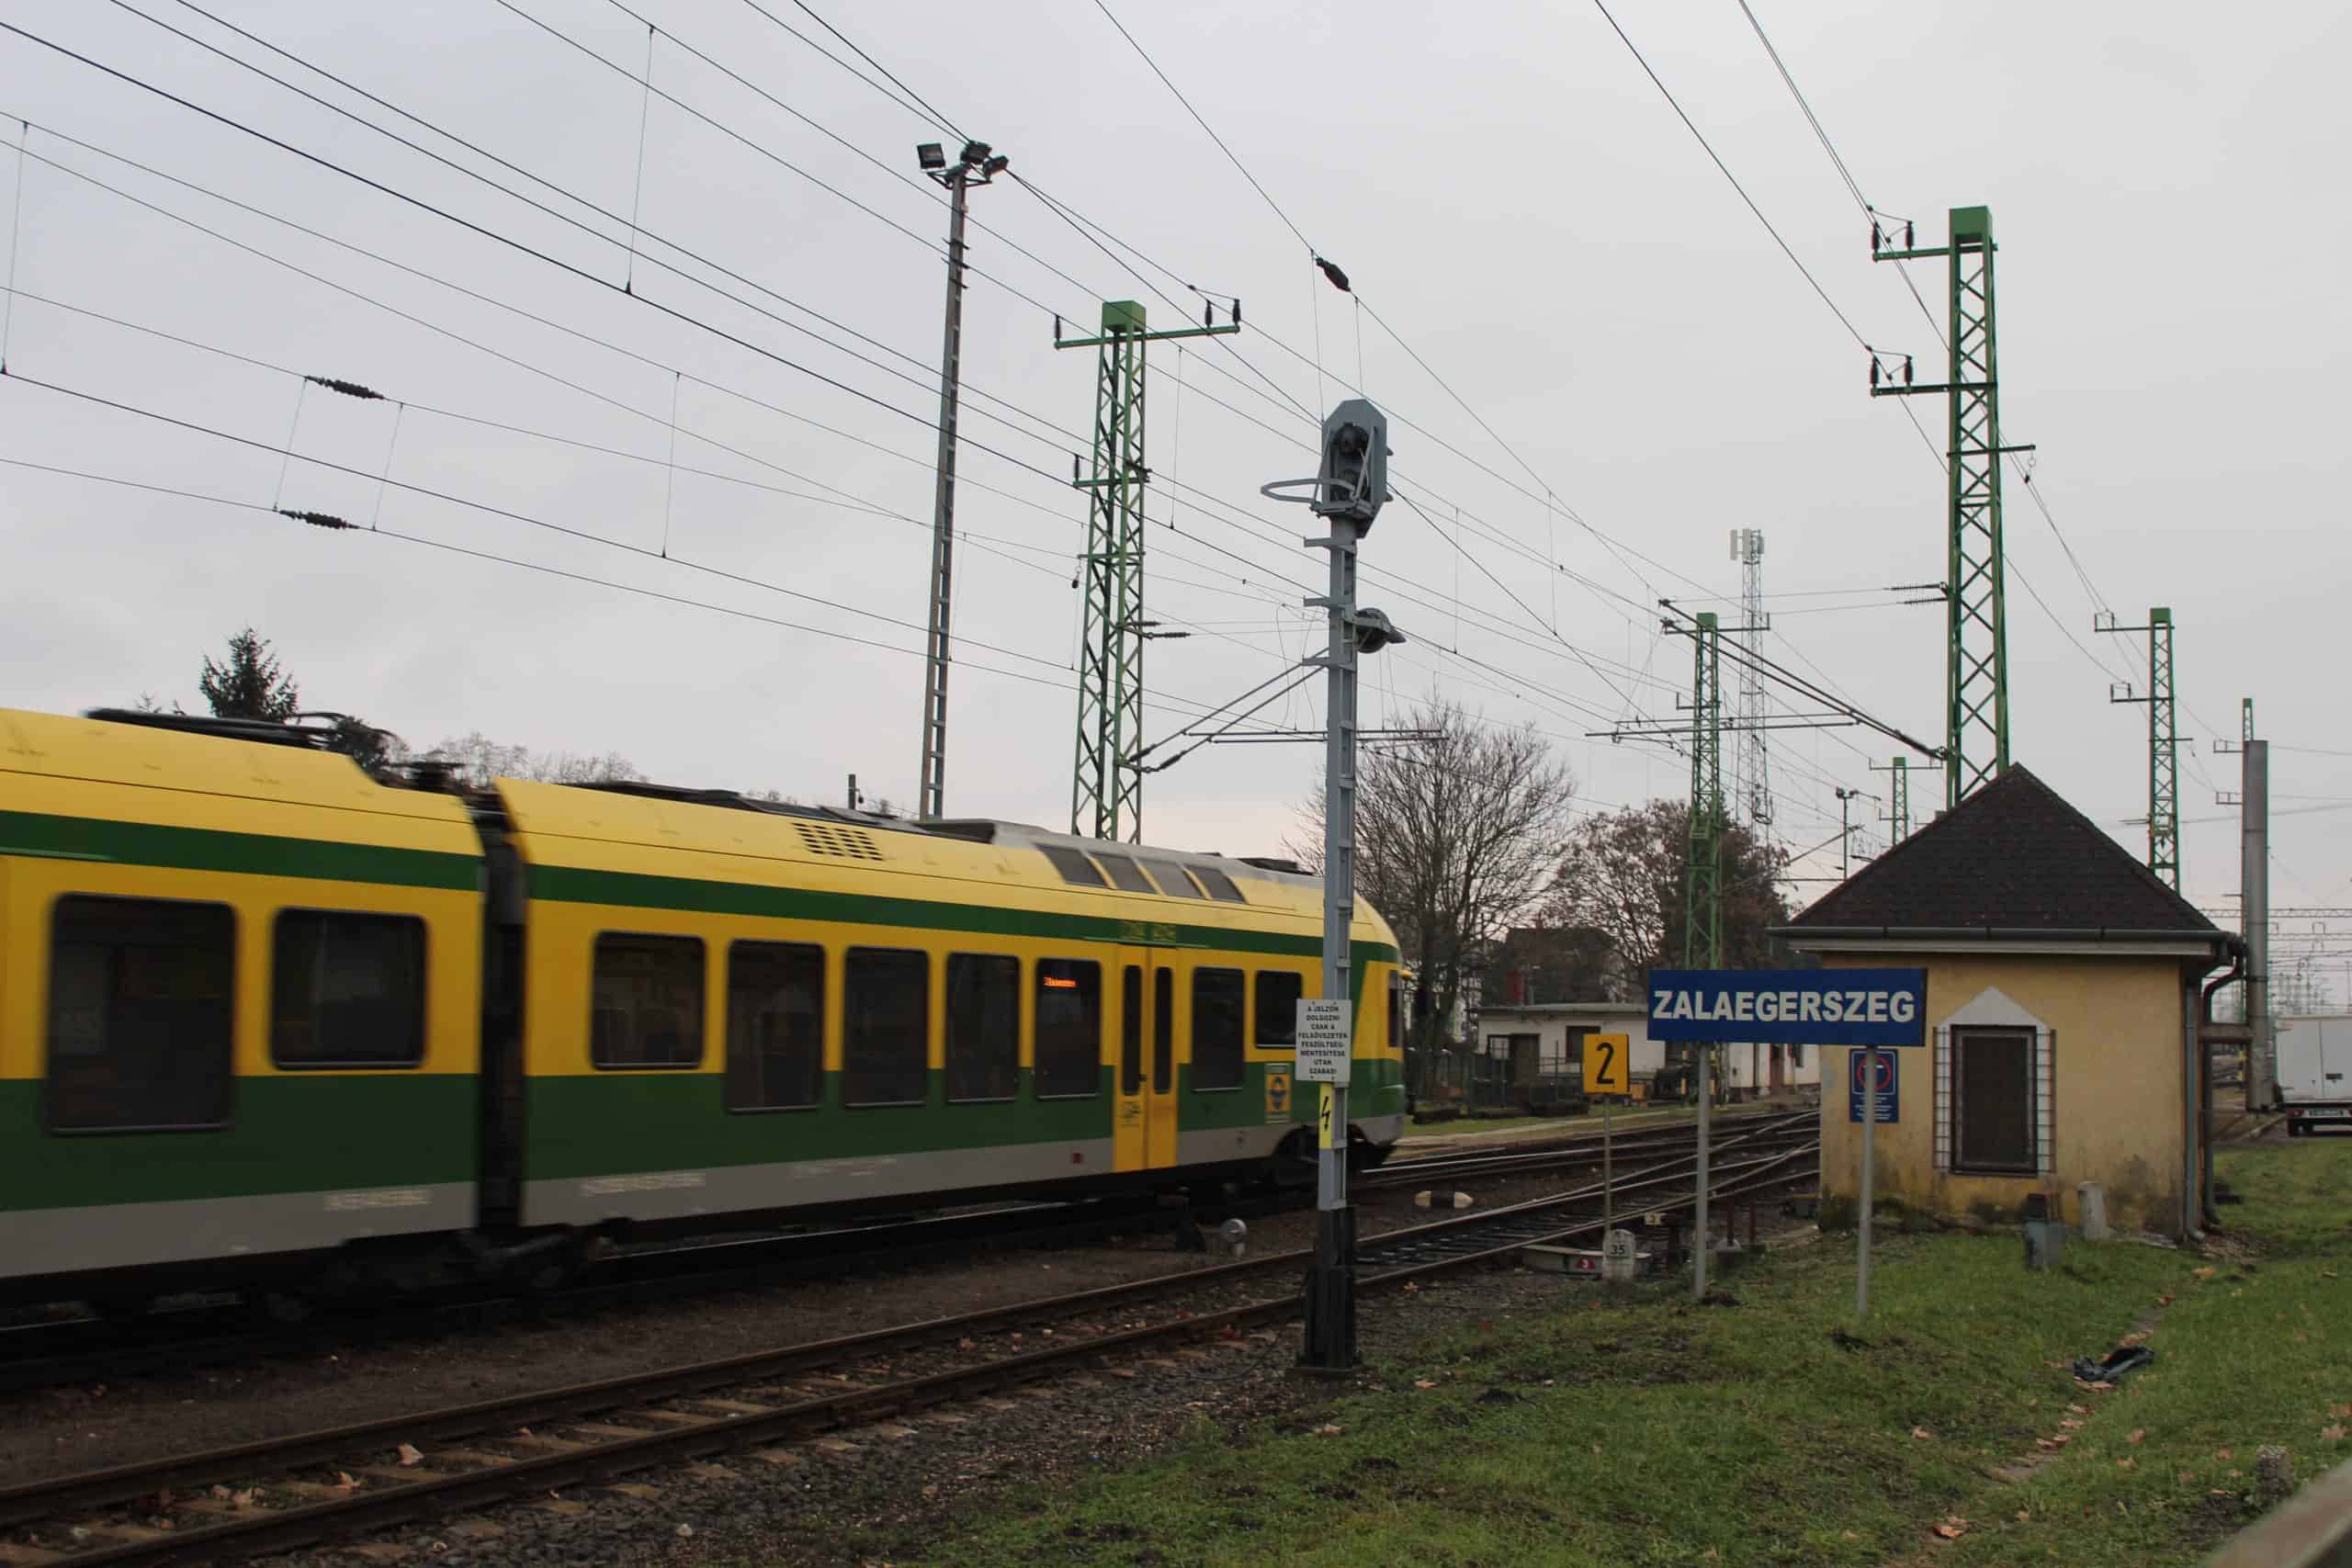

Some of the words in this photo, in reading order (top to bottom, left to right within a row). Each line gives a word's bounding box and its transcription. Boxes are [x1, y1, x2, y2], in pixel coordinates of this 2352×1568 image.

[1653, 989, 1915, 1022] ZALAEGERSZEG
[1596, 1042, 1615, 1085] 2
[1610, 1244, 1625, 1256] 35
